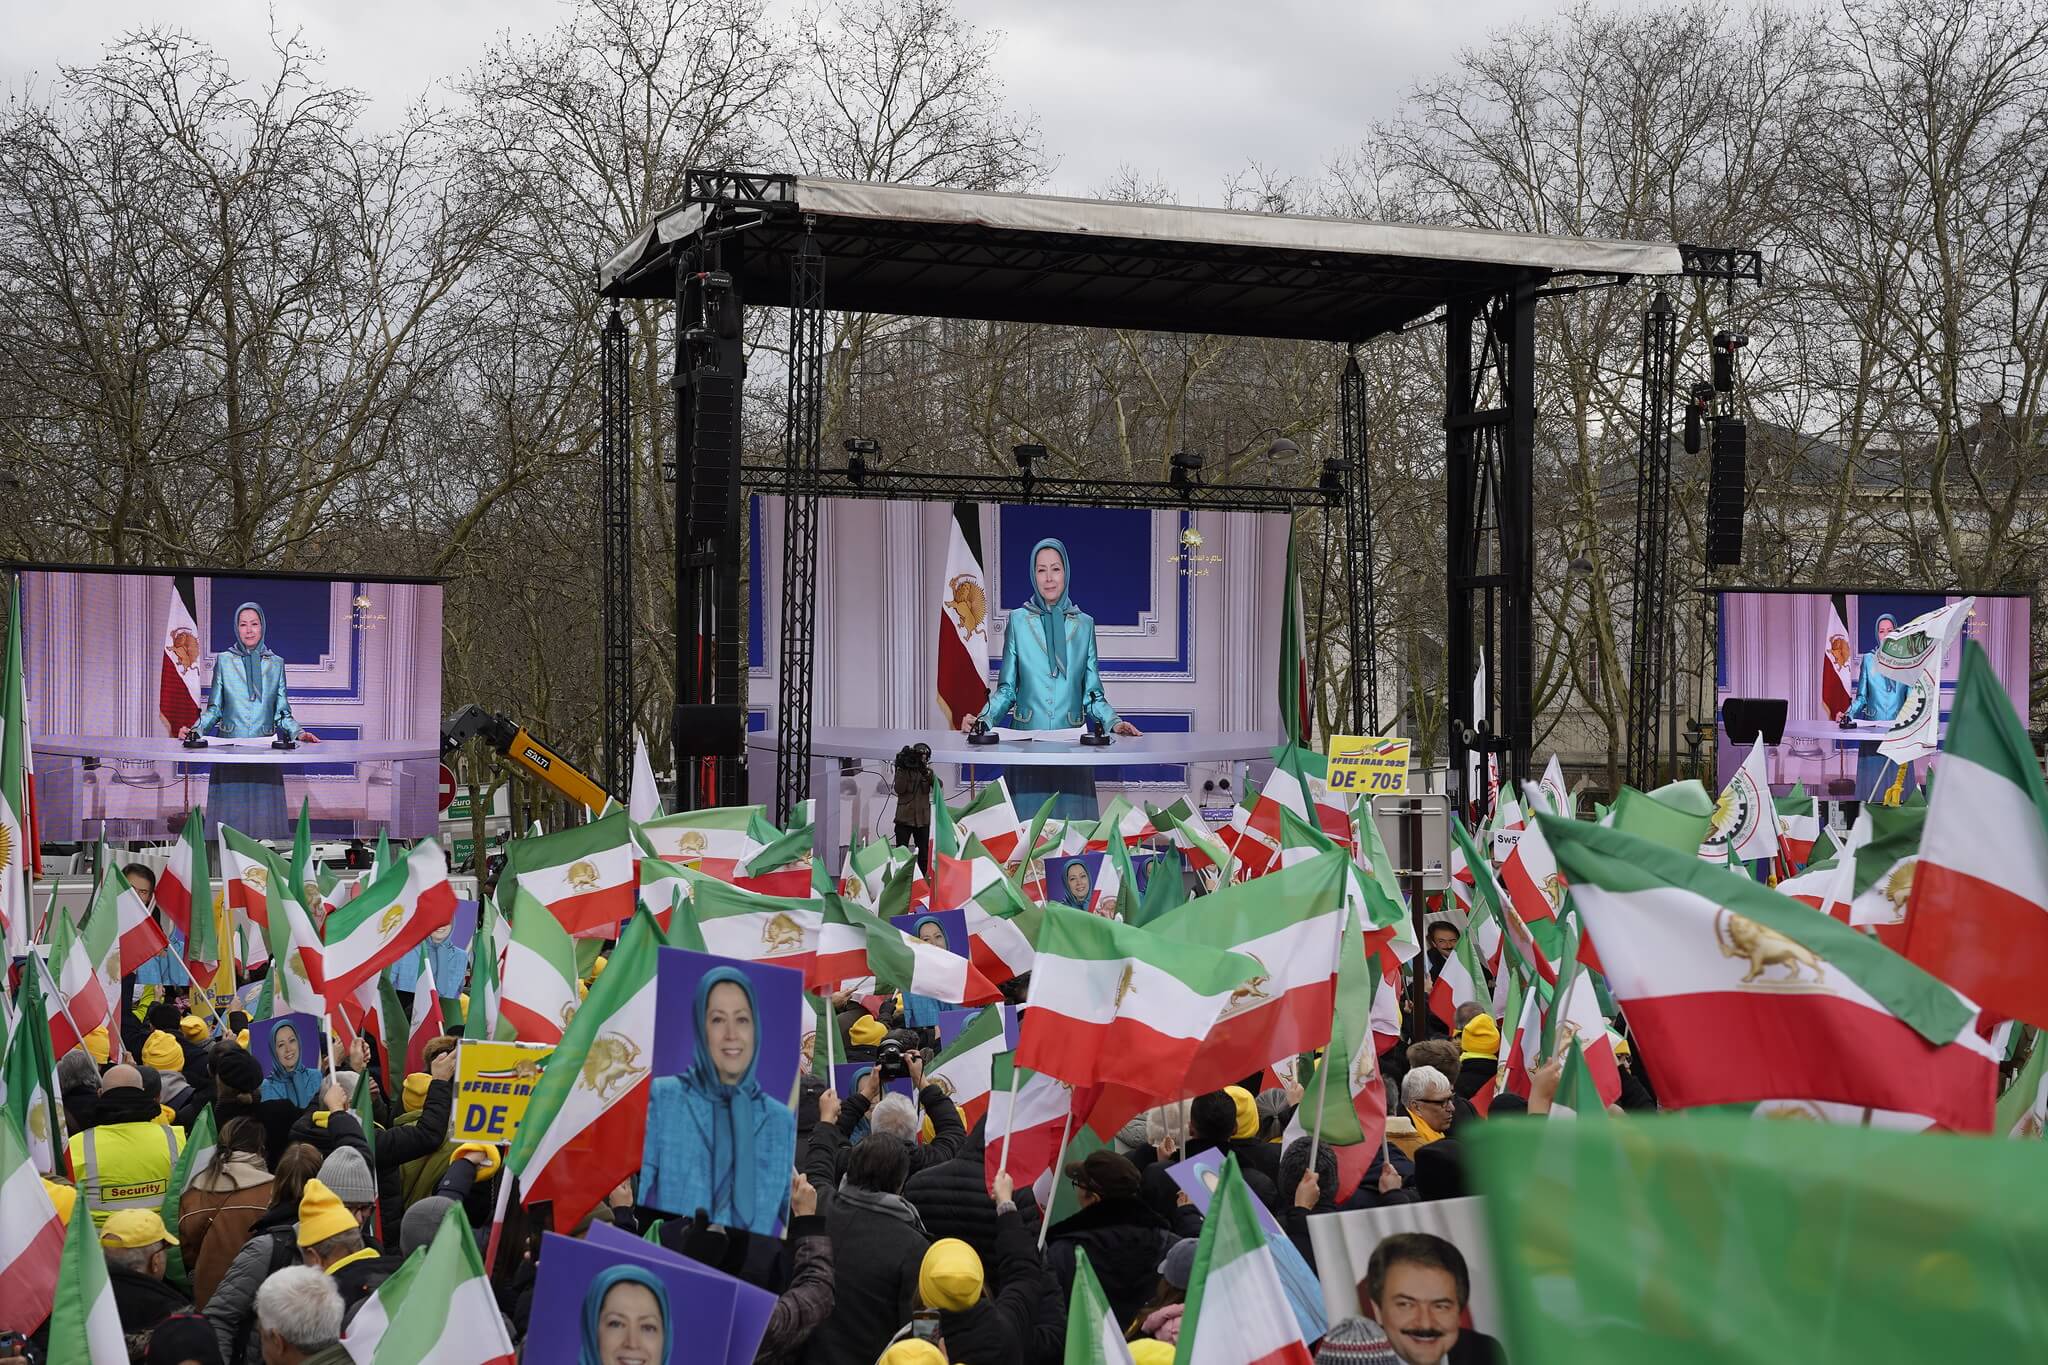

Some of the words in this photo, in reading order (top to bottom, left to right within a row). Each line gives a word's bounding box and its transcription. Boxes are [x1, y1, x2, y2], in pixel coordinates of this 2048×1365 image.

[1331, 757, 1360, 765] #FREE
[1360, 758, 1383, 766] IRAN
[1384, 759, 1406, 768] 2025
[1331, 769, 1357, 788] DE
[1370, 772, 1403, 790] 705
[462, 1080, 512, 1095] #FREE
[513, 1084, 536, 1097] IR
[463, 1103, 509, 1134] DE
[111, 1183, 161, 1197] Security
